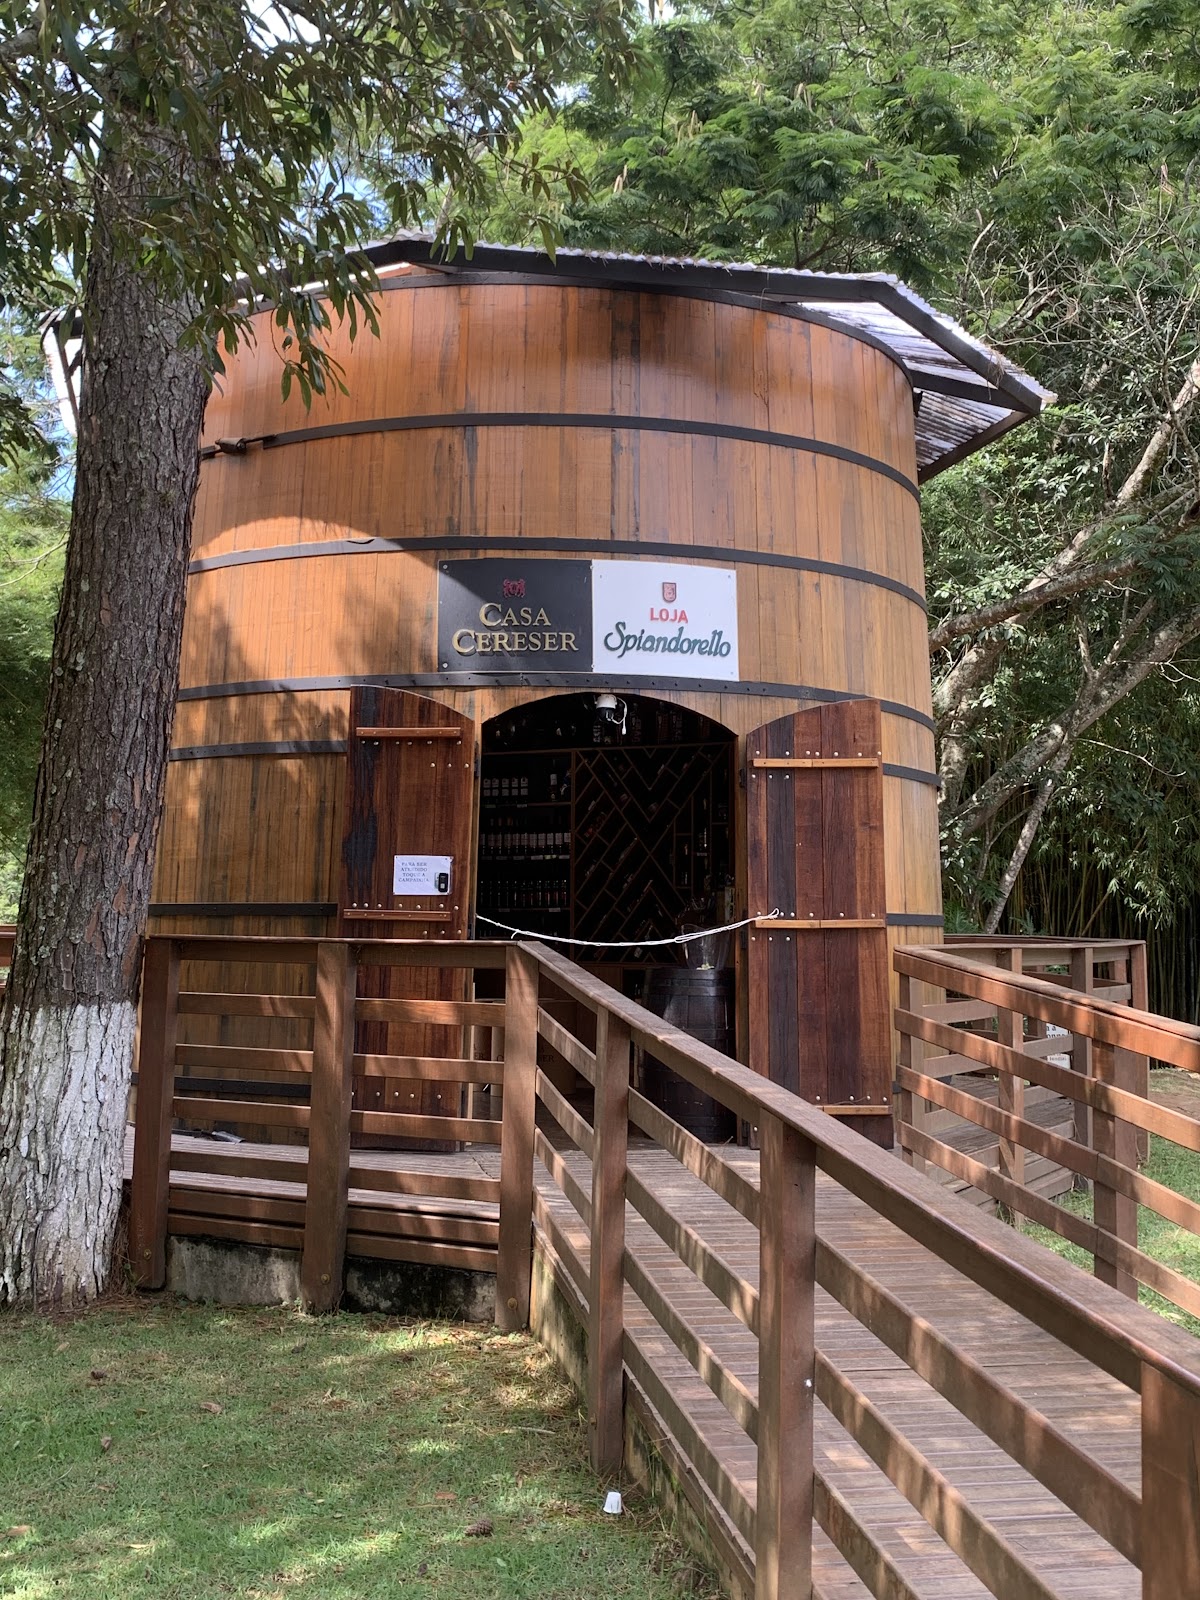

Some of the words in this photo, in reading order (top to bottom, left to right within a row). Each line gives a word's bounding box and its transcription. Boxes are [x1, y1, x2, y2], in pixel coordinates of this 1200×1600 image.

[479, 602, 552, 628] CASA
[649, 607, 689, 624] LOJA
[451, 628, 579, 654] CERESER
[603, 621, 732, 659] Spiandorello
